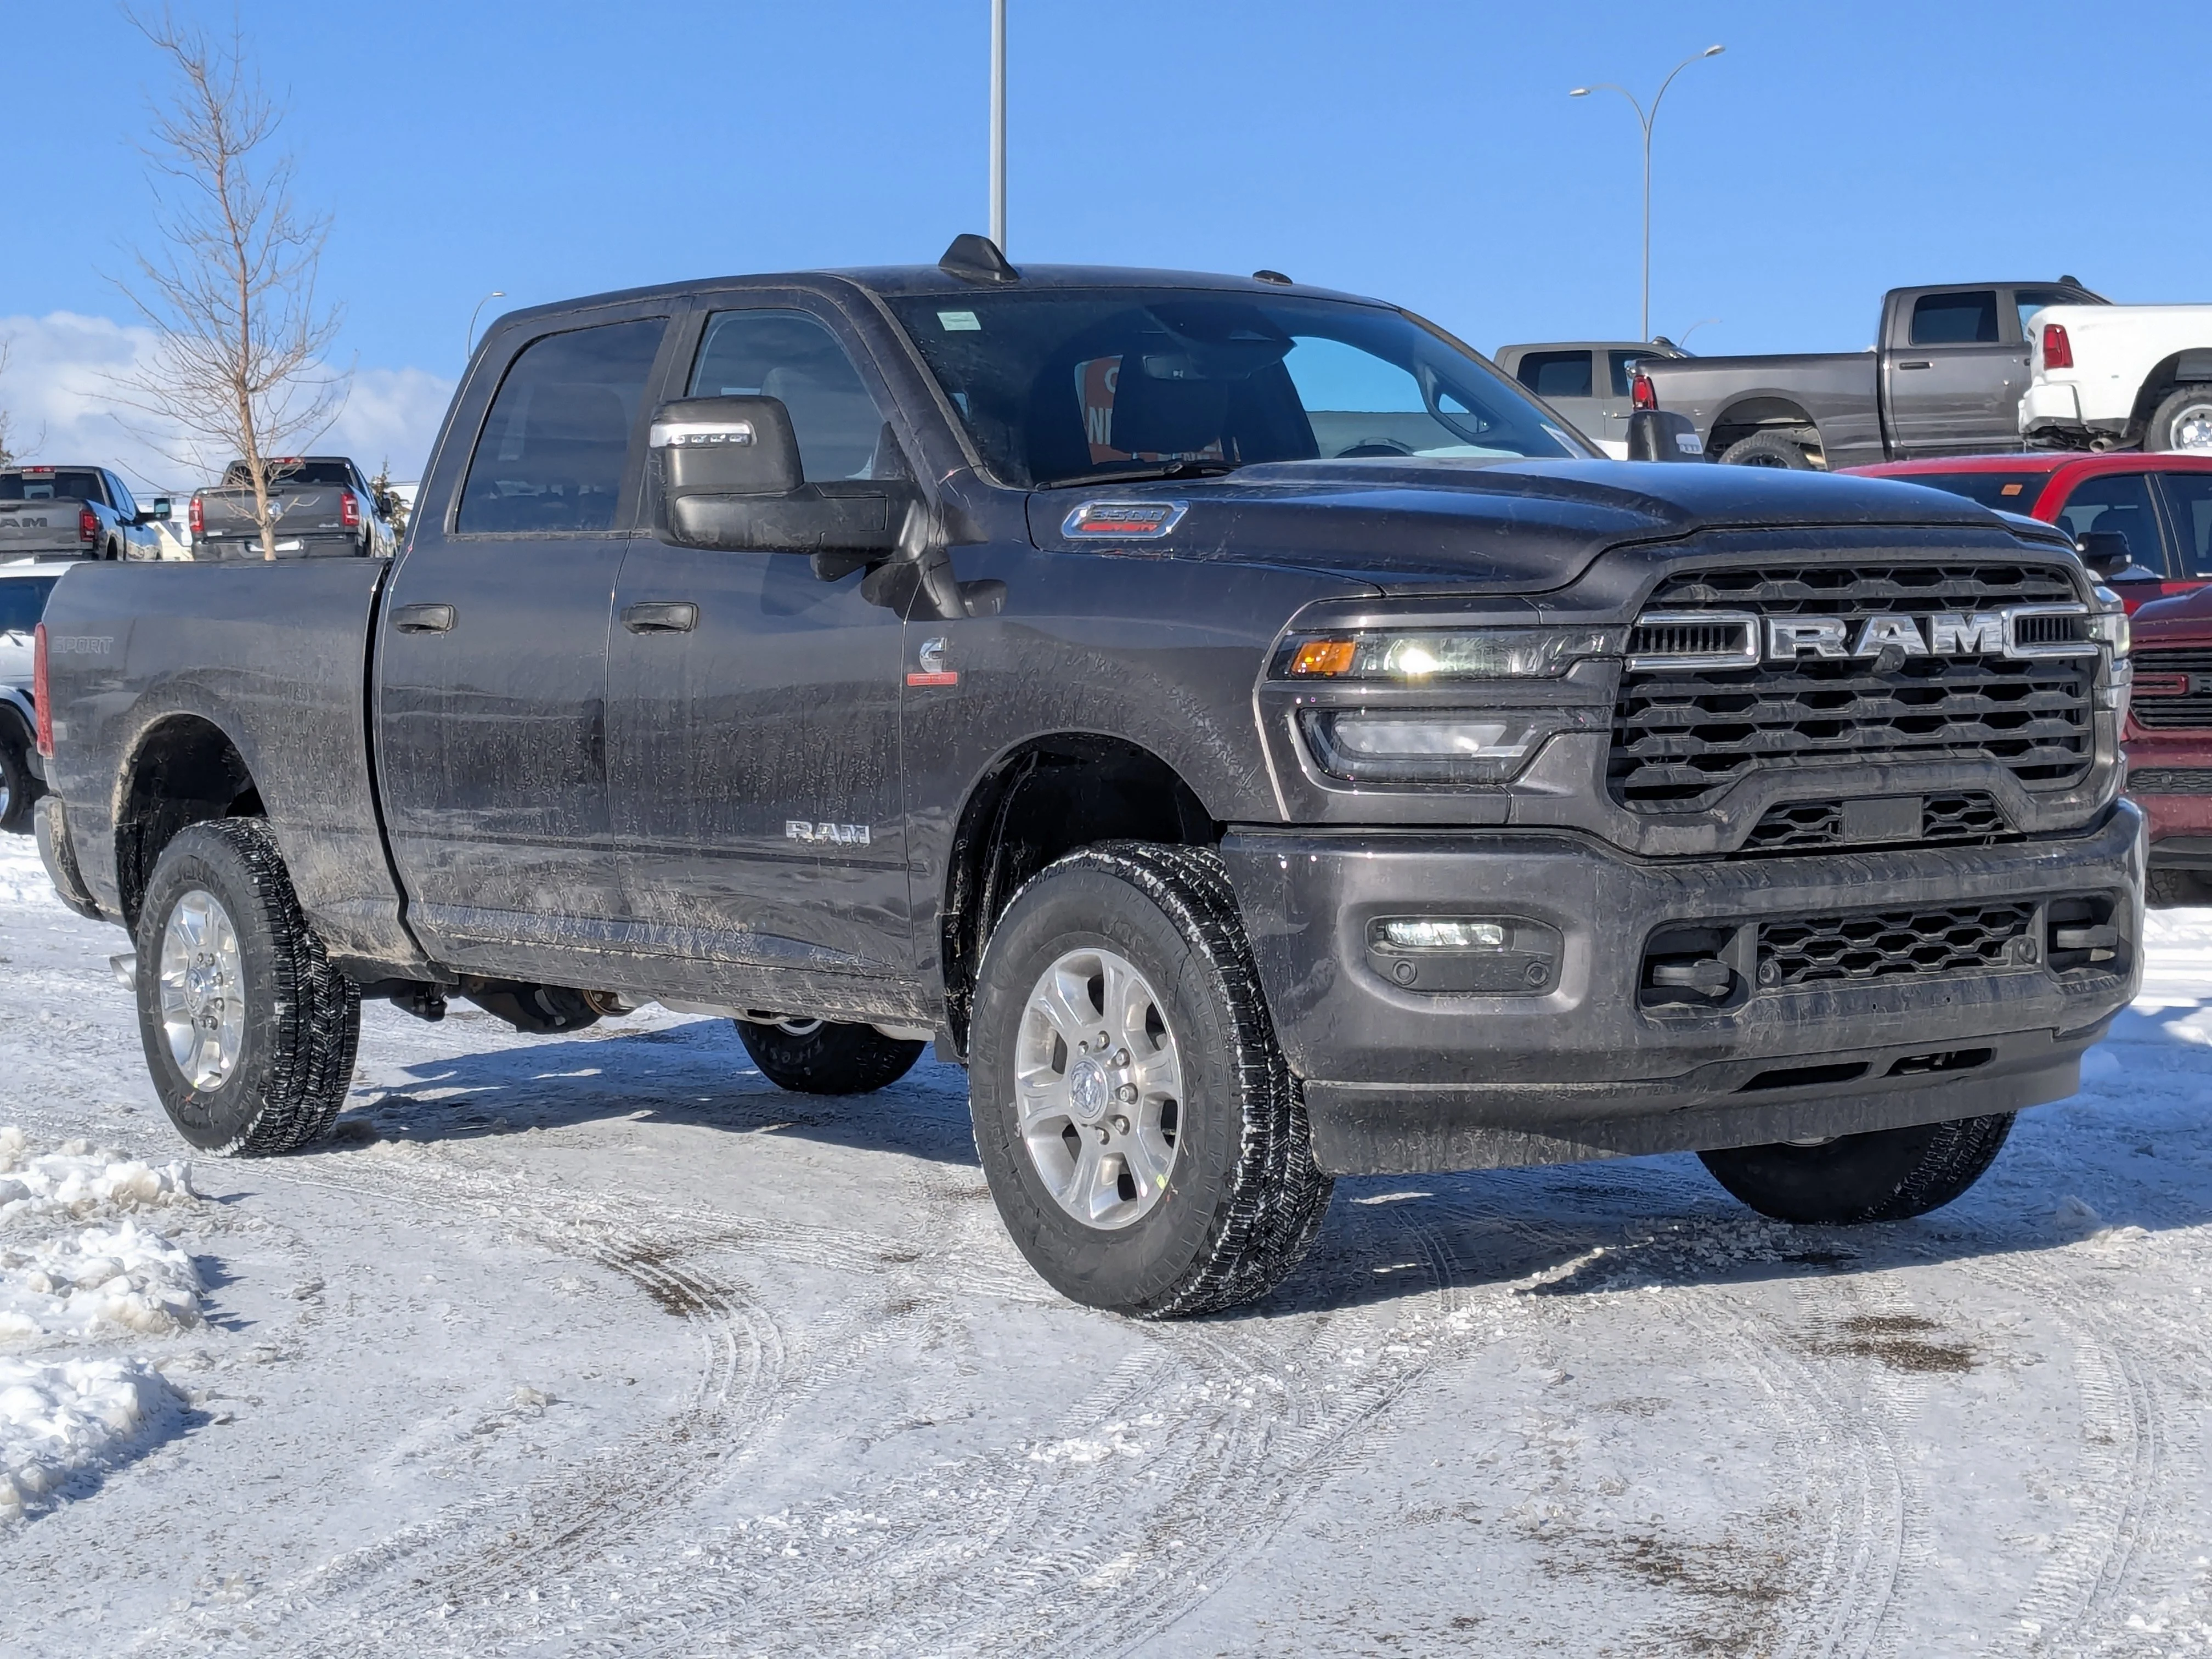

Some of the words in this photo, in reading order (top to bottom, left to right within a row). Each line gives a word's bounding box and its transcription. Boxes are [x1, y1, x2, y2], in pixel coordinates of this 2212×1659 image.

[52, 636, 114, 654] SPORT
[1769, 614, 2004, 659] RAM
[786, 820, 871, 845] RAM
